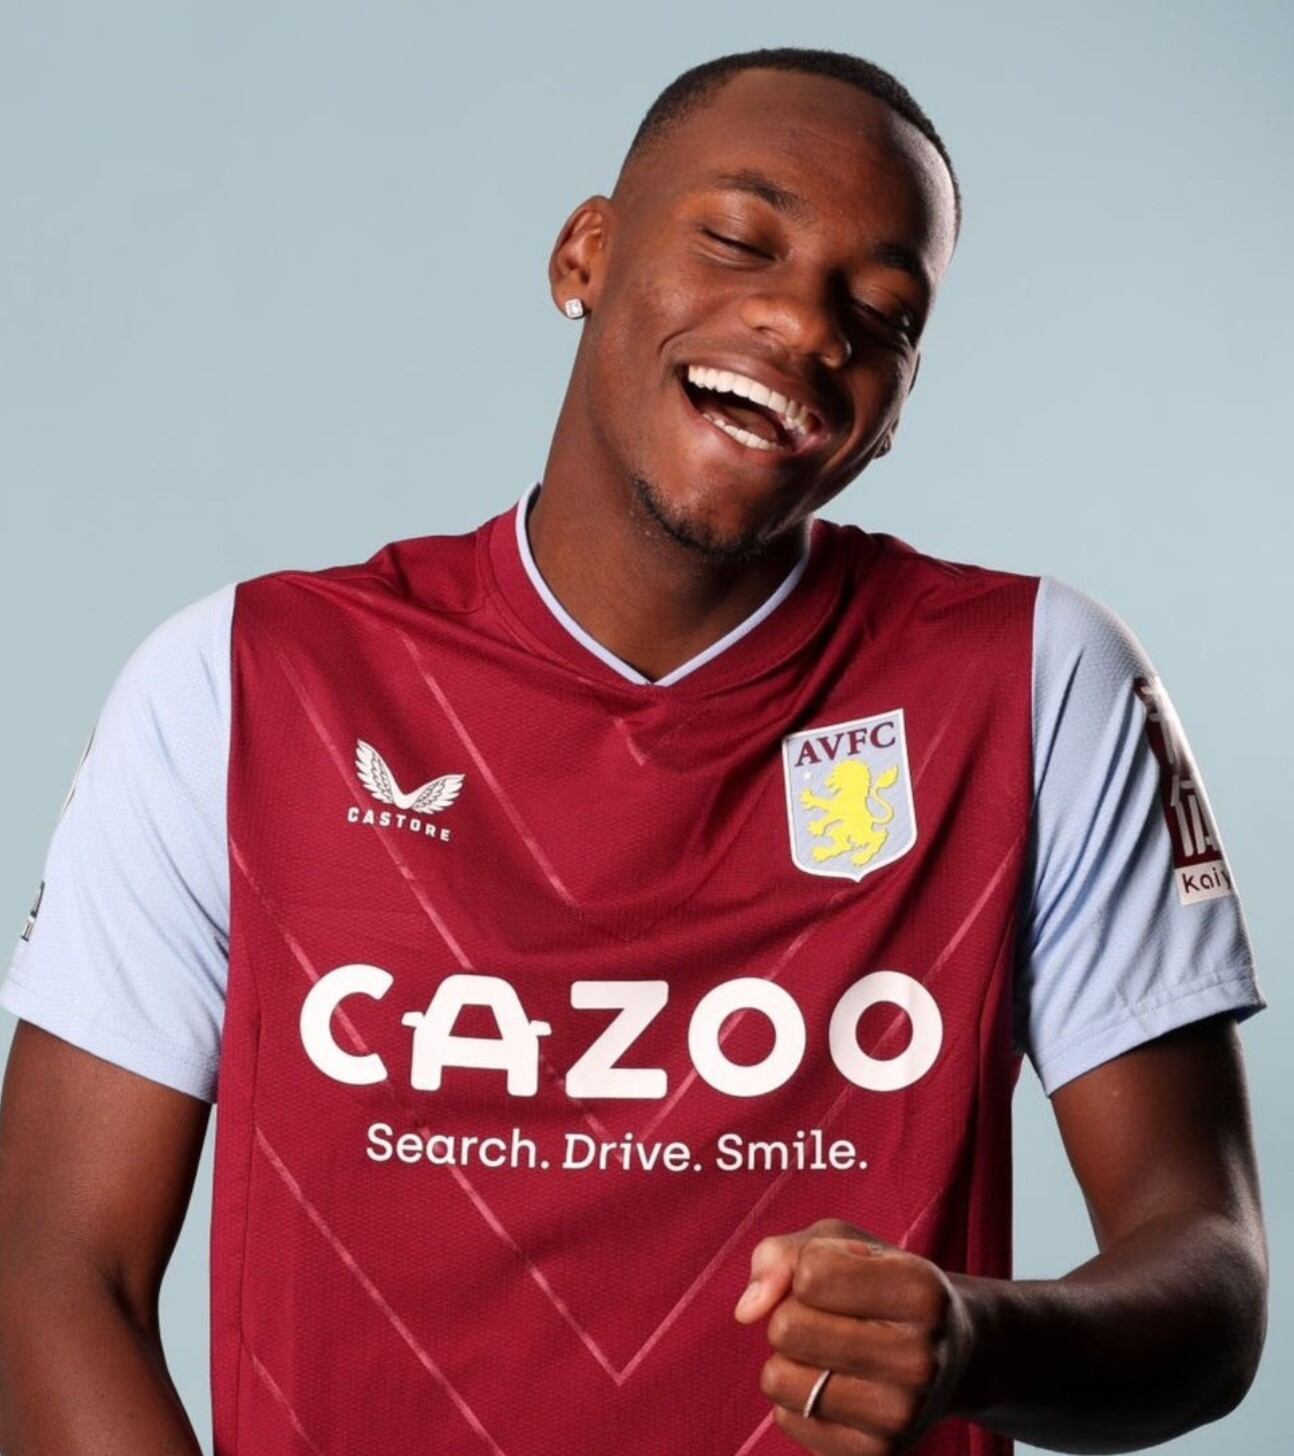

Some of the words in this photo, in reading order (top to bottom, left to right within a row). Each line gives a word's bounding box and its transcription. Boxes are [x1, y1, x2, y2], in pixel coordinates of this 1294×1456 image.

[794, 721, 897, 768] AVFC
[347, 806, 451, 842] CASTORE
[300, 963, 944, 1101] CAZOO
[366, 1122, 550, 1170] Search.
[562, 1132, 702, 1172] Drive.
[716, 1129, 868, 1170] Smile.
